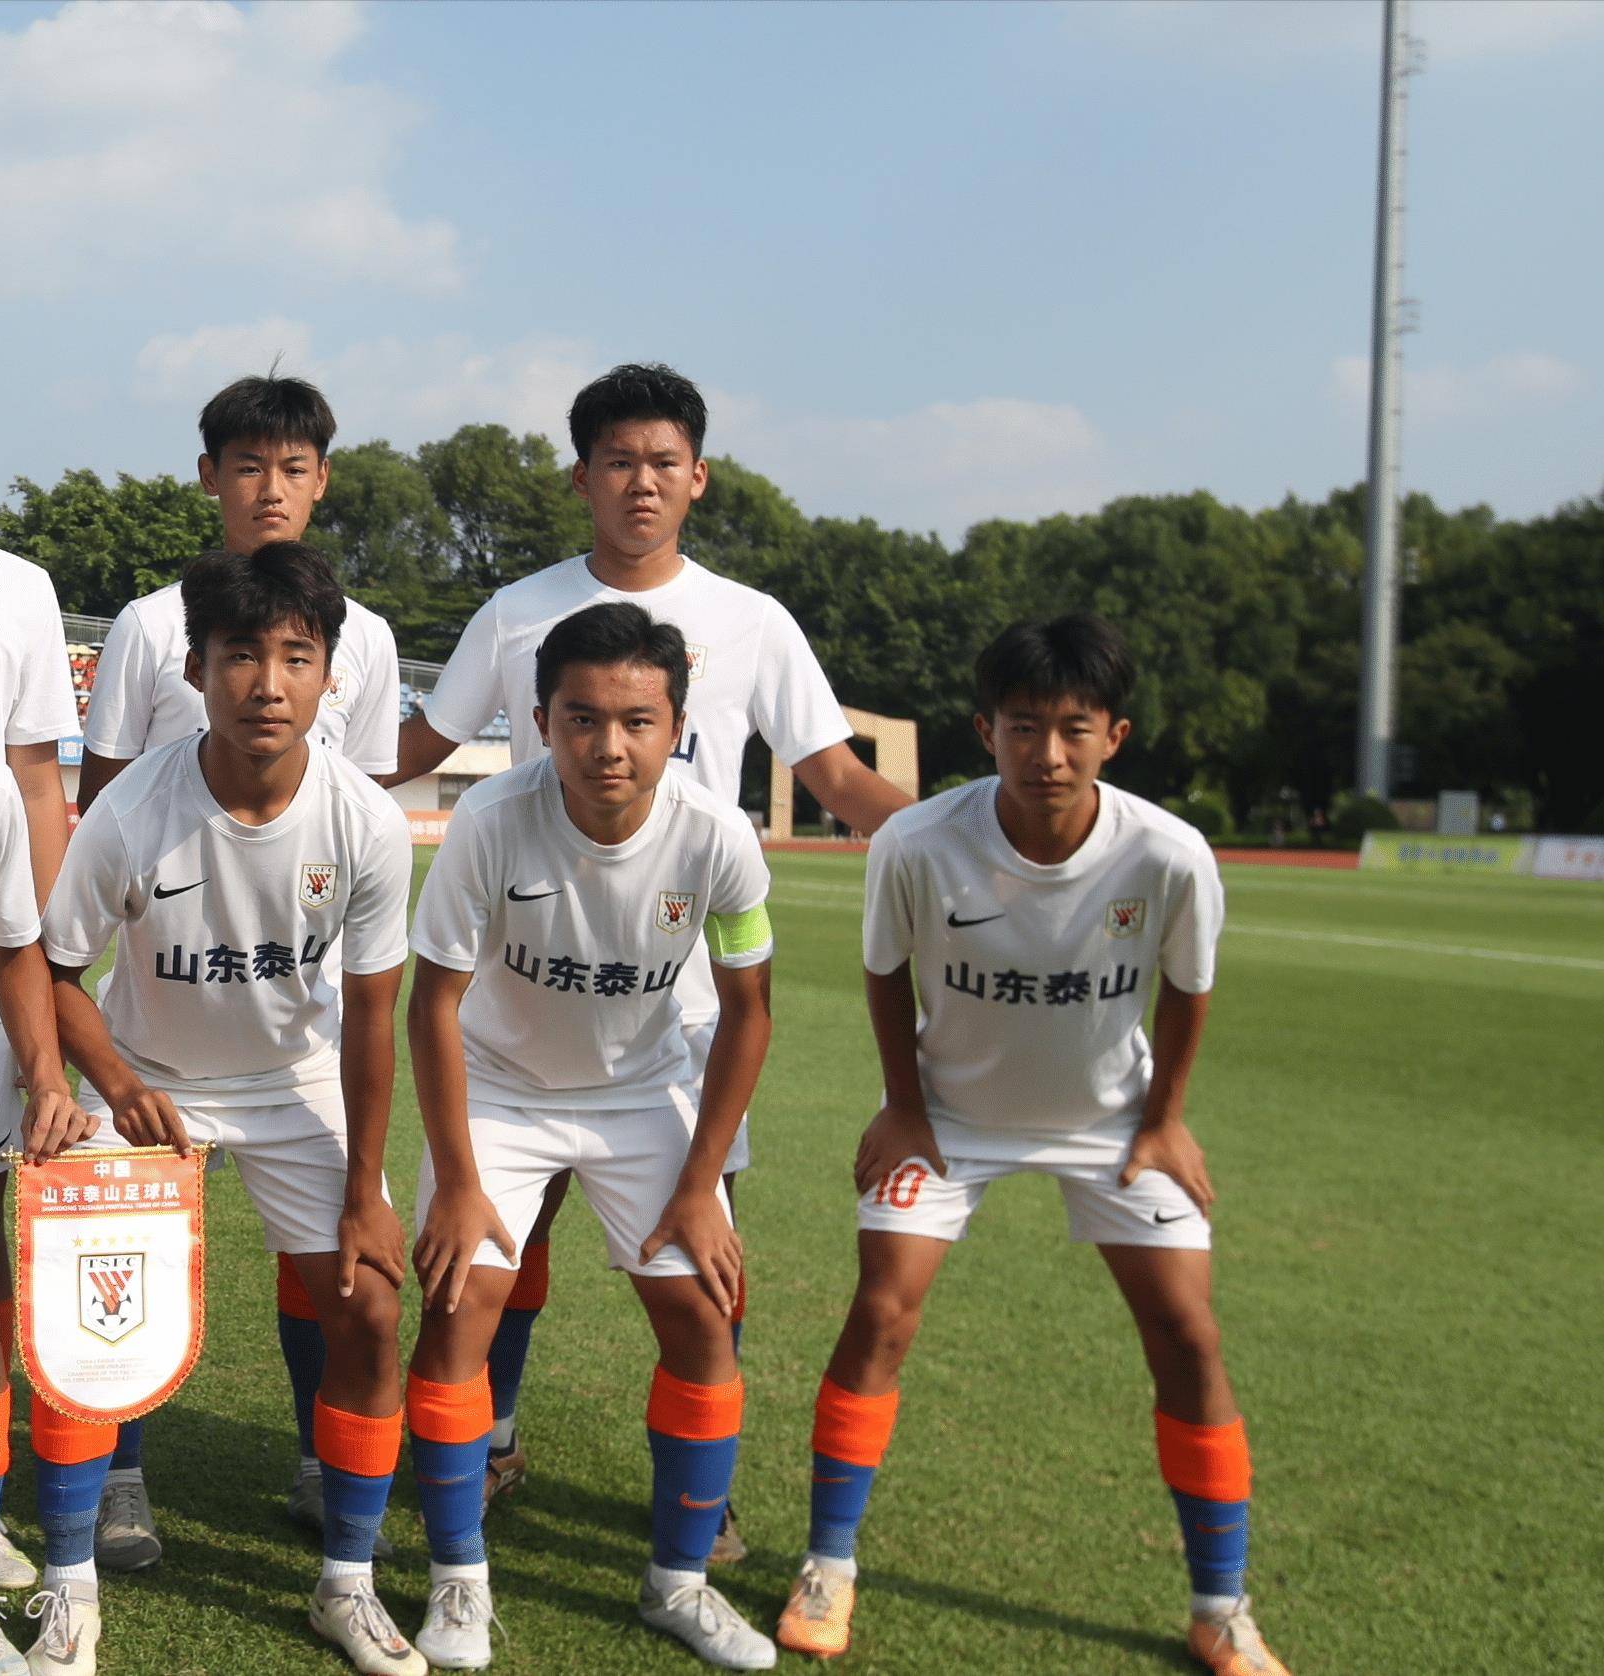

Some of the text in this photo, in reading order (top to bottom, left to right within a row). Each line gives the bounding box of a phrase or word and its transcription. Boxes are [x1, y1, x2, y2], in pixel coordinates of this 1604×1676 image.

[155, 935, 328, 984] 山东泰山
[504, 941, 682, 997] 山东泰山
[945, 961, 1139, 1005] 山东泰山
[41, 1182, 180, 1203] 山东泰山足球队
[874, 1163, 928, 1210] 10
[86, 1257, 137, 1269] TSFC
